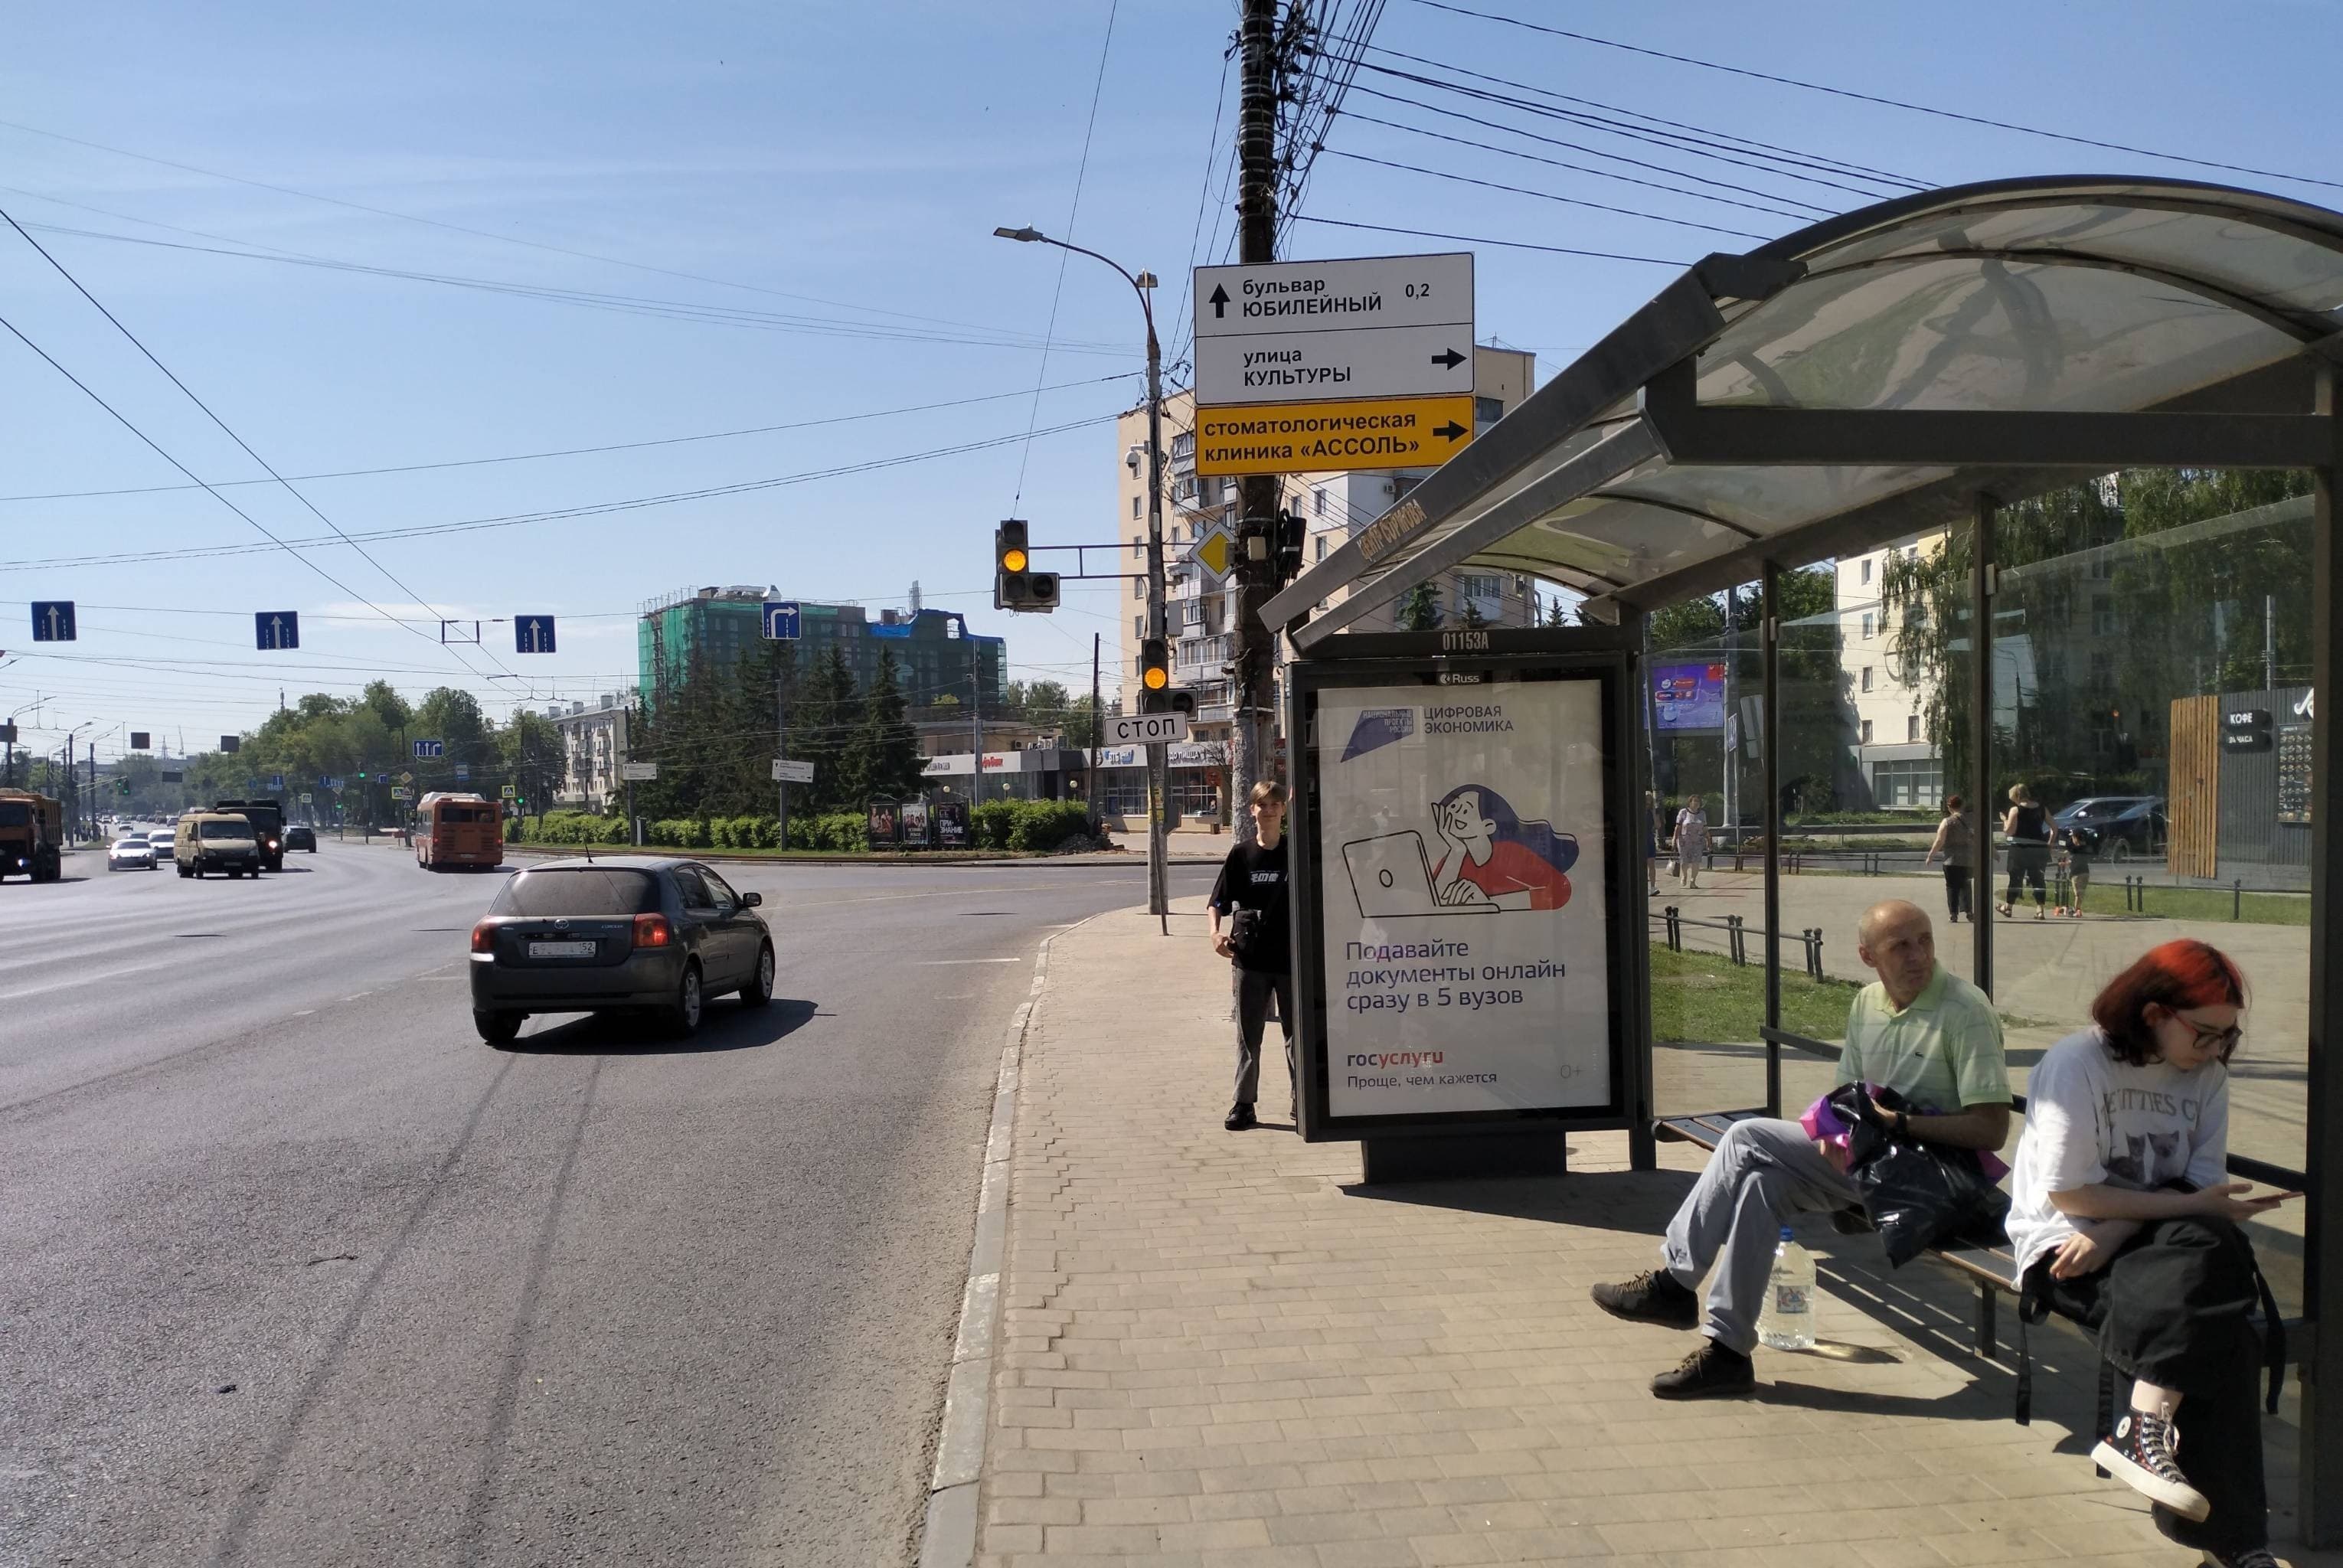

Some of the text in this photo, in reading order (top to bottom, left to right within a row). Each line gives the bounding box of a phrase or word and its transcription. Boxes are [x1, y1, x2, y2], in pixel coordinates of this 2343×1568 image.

[1243, 279, 1325, 296] бульвар
[1405, 283, 1430, 299] 0,2
[1243, 291, 1382, 318] ЮБИЛЕЙНЫЙ
[1243, 348, 1302, 368] улица
[1243, 367, 1351, 387] КУЛЬТУРЫ
[1204, 413, 1417, 436] стоматологическая
[1204, 436, 1420, 462] клиника «АССОЛЬ»
[1453, 674, 1480, 684] Russ
[1424, 705, 1502, 721] ЦИФРОВАЯ
[2230, 713, 2253, 724] КОФЕ
[1117, 718, 1175, 739] СТОП
[1424, 720, 1514, 733] ЭКОНОМИКА
[1346, 938, 1469, 962] Подавайте
[1346, 959, 1566, 988] документы онлайн
[1347, 987, 1524, 1014] сразу в 5 вузов
[1347, 1050, 1444, 1070] госуслуги
[1348, 1071, 1498, 1091] Проще, чем кажется
[1560, 1063, 1583, 1079] 0+
